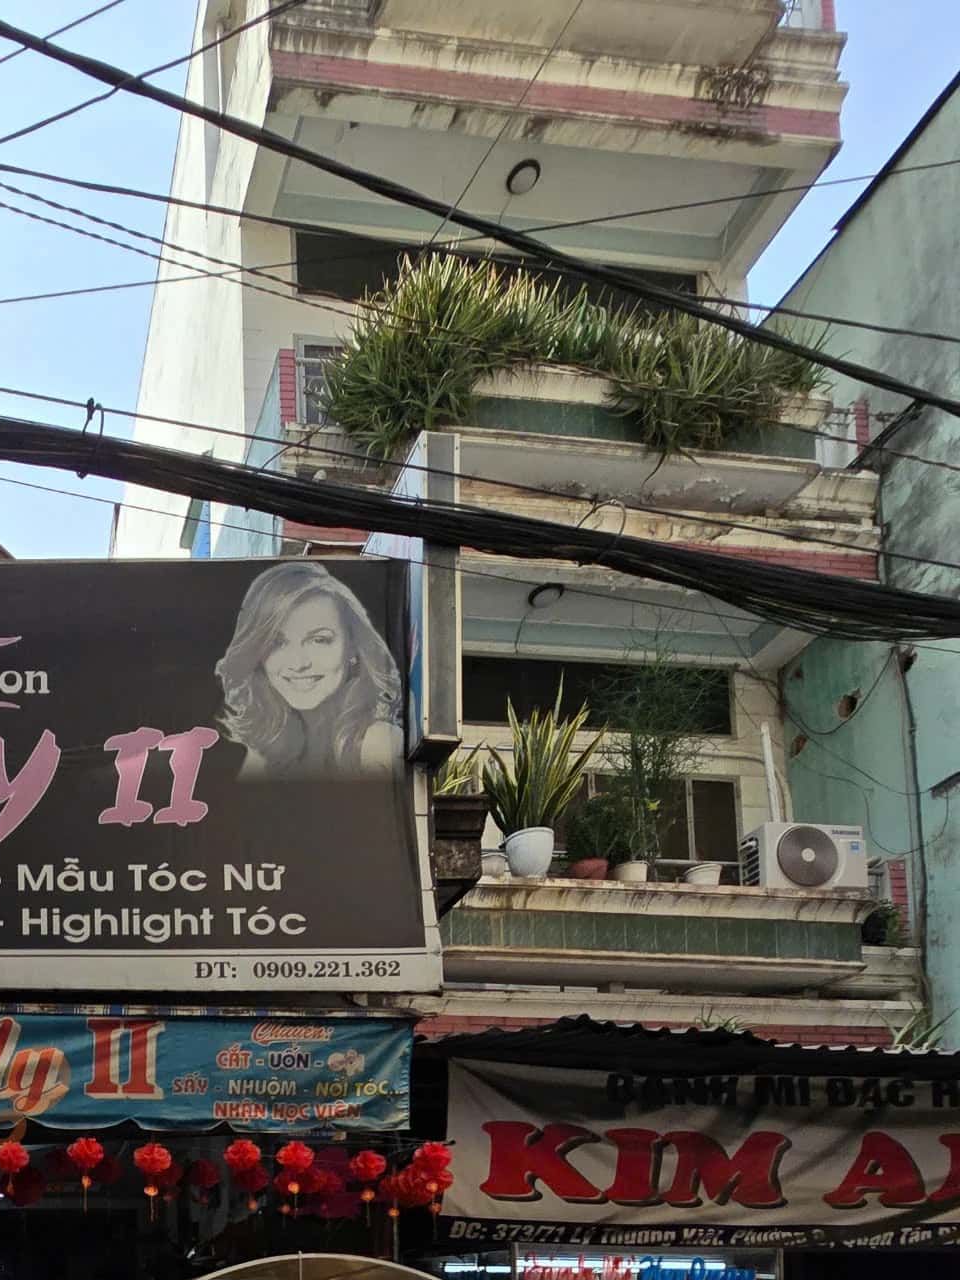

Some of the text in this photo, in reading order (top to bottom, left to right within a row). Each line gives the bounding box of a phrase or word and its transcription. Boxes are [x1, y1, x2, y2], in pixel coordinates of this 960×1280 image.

[98, 726, 219, 827] II
[17, 858, 115, 892] Mẫu
[128, 863, 208, 892] Tóc
[223, 863, 286, 892] Nữ
[21, 907, 214, 943] Highlight
[226, 905, 308, 936] Tóc
[195, 960, 401, 979] ĐT: 0909.221.362
[84, 1017, 166, 1100] II
[216, 1041, 253, 1070] CẮT
[269, 1042, 310, 1070] UỐN
[228, 1077, 297, 1100] NHUỘM
[213, 1098, 361, 1124] NHẬN HỌC VIÊN
[479, 1120, 792, 1209] KIM
